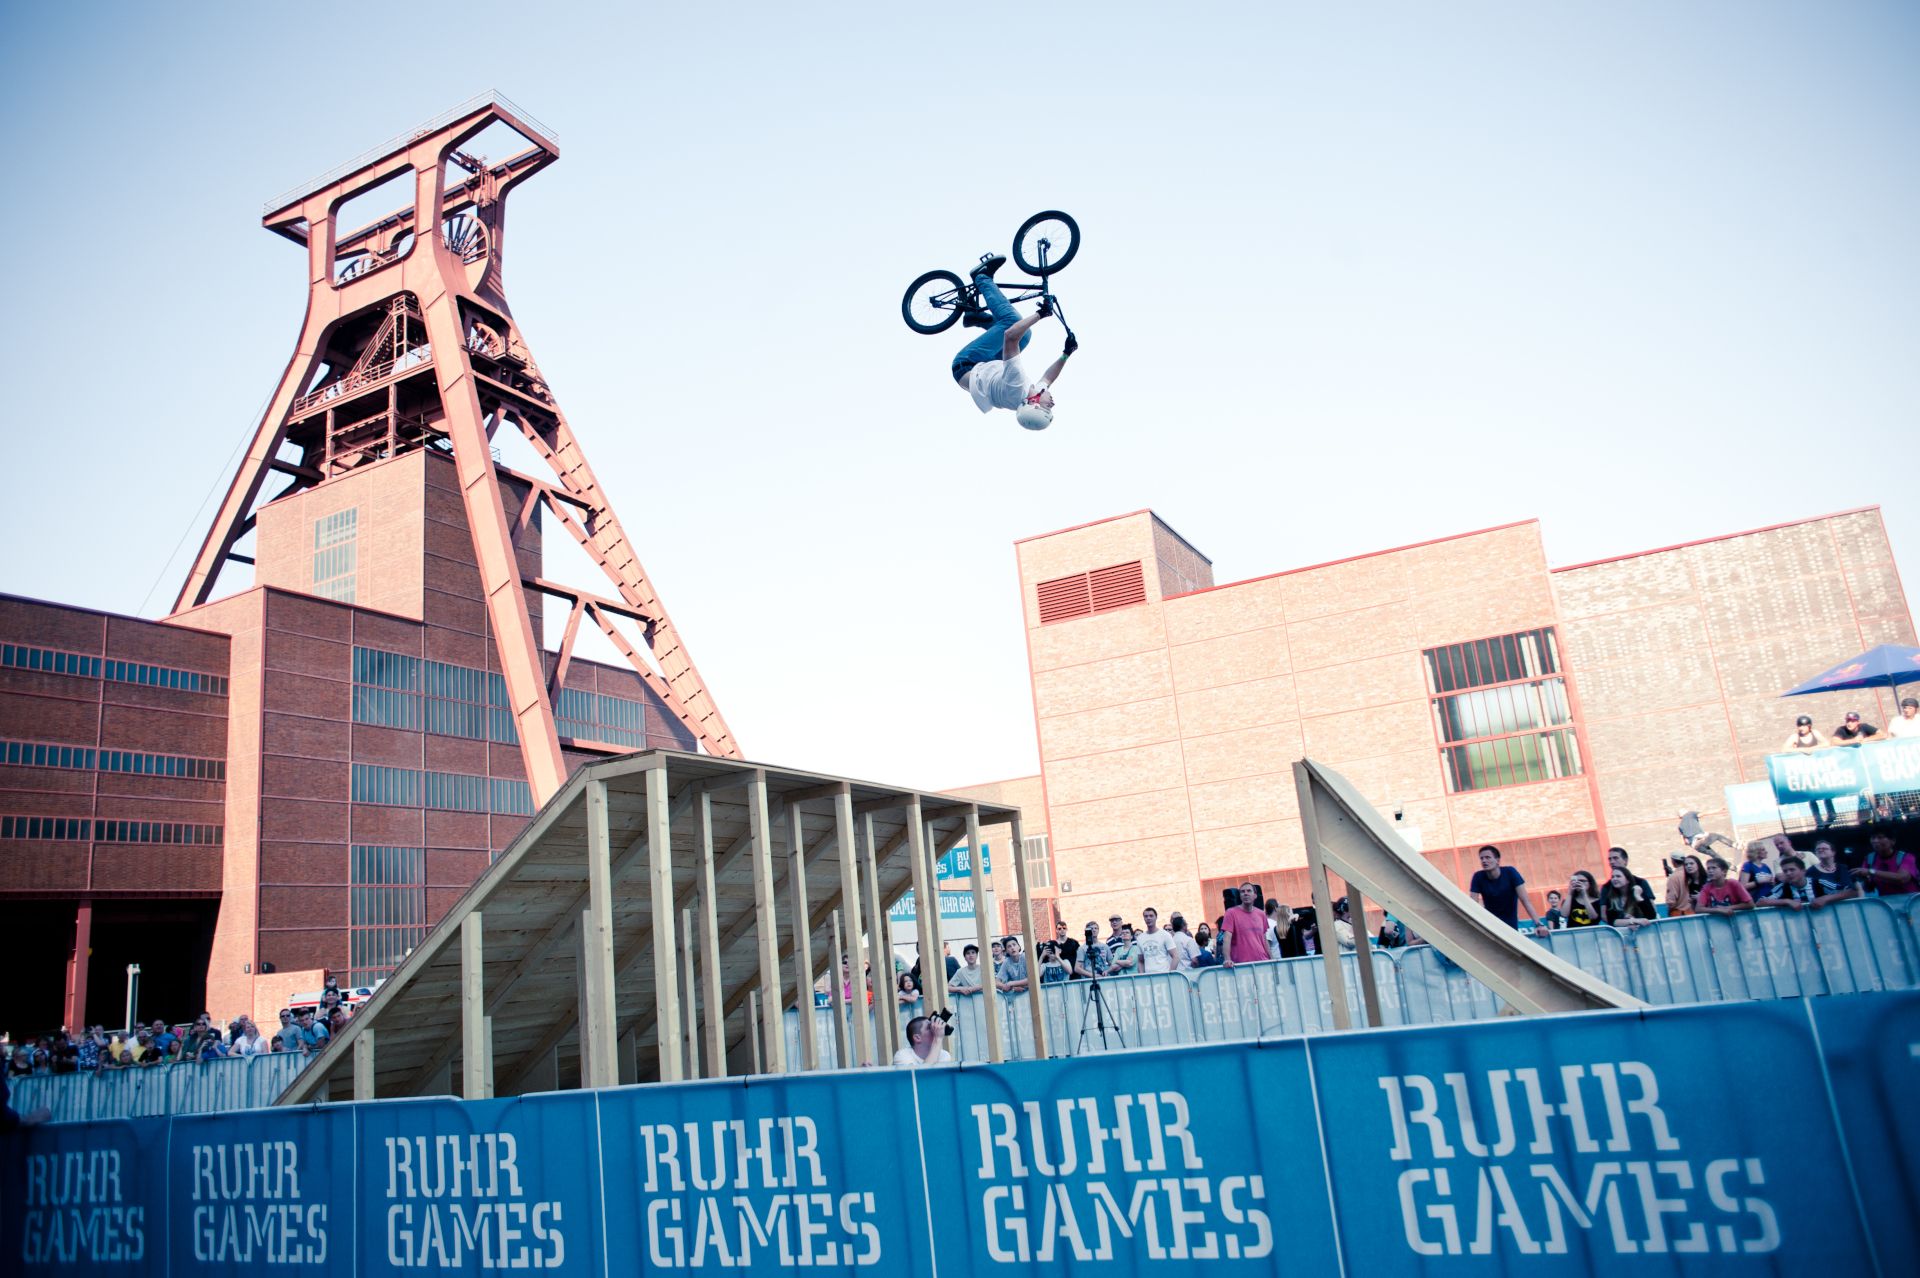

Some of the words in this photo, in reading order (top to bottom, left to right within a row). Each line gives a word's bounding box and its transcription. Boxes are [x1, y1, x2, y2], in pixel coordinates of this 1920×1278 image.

[971, 1091, 1204, 1179] RUHR
[1377, 1061, 1681, 1160] RUHR
[26, 1150, 123, 1206] RUHR
[192, 1141, 301, 1200] RUHR
[385, 1132, 523, 1198] RUHR
[640, 1116, 827, 1192] RUHR
[23, 1206, 145, 1264] GAMES
[193, 1203, 327, 1264] GAMES
[387, 1201, 565, 1269] GAMES
[642, 1192, 882, 1268] GAMES
[983, 1174, 1274, 1263] GAMES
[1397, 1158, 1781, 1255] GAMES
